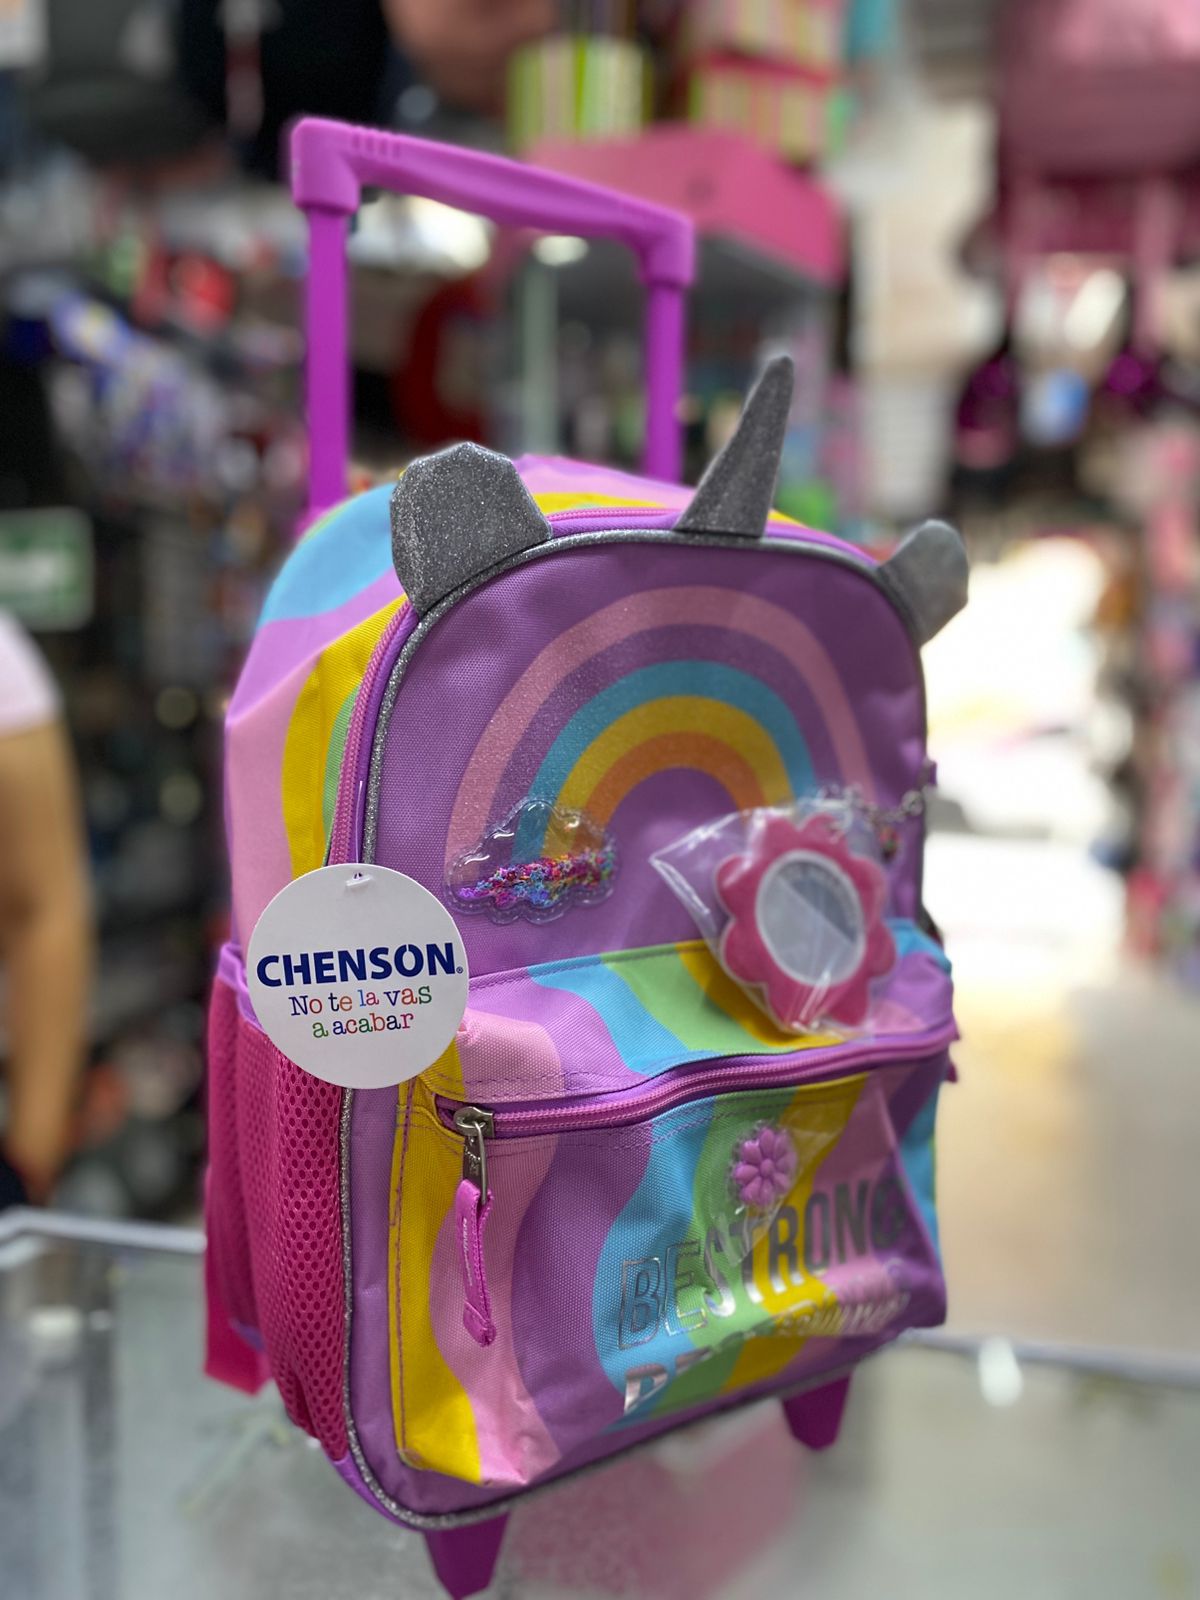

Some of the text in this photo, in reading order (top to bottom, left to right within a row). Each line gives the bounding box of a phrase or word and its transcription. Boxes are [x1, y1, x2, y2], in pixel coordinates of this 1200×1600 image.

[288, 985, 433, 1016] No te la vas
[312, 1012, 414, 1038] a acabar
